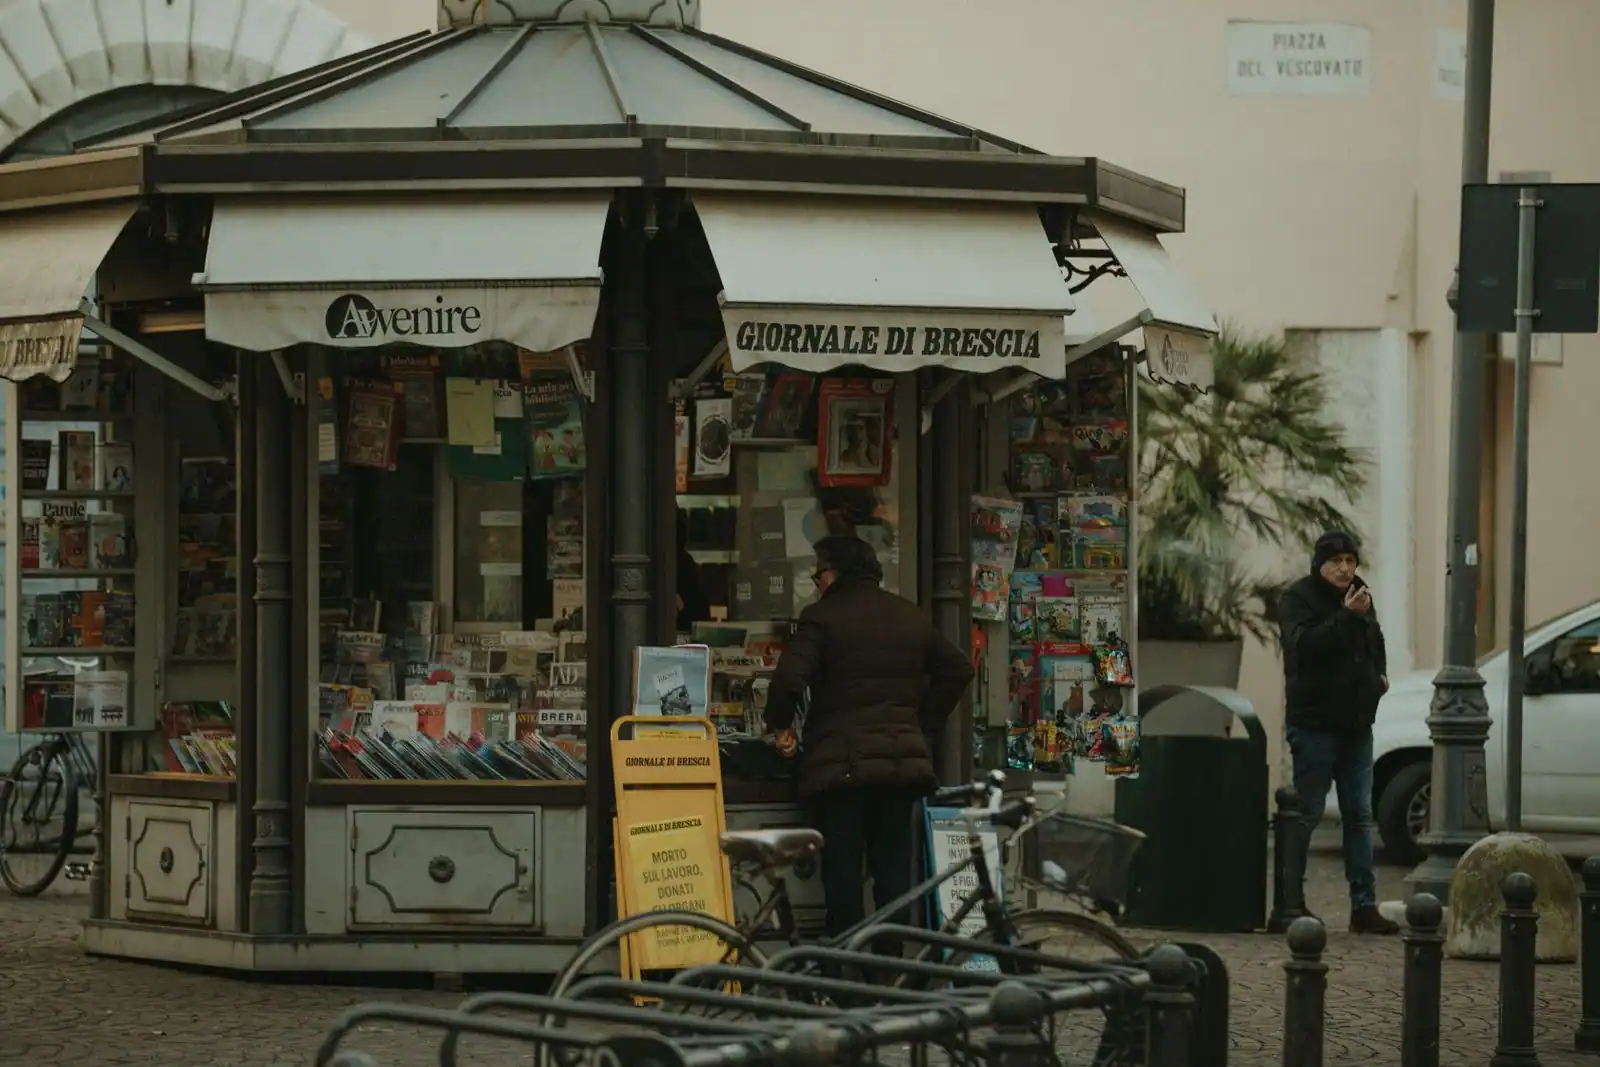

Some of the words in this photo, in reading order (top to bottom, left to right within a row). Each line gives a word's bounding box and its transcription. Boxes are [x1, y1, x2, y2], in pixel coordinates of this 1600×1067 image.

[1273, 33, 1326, 49] PIAZZA
[1237, 61, 1265, 77] DEL
[1276, 60, 1363, 77] VESCOVATO
[736, 322, 878, 354] GIORNALE
[884, 327, 916, 356] DI
[922, 327, 1041, 358] BRESCIA
[43, 501, 85, 517] Parole
[541, 713, 583, 722] BRERA
[626, 757, 665, 767] GIORNALE
[667, 757, 675, 766] DI
[677, 757, 711, 766] BRESCIA
[630, 822, 663, 835] GIORNALE
[672, 818, 702, 830] BRESCIA
[652, 848, 687, 863] MORTO
[643, 871, 660, 883] SUL
[657, 883, 694, 899] DONATI
